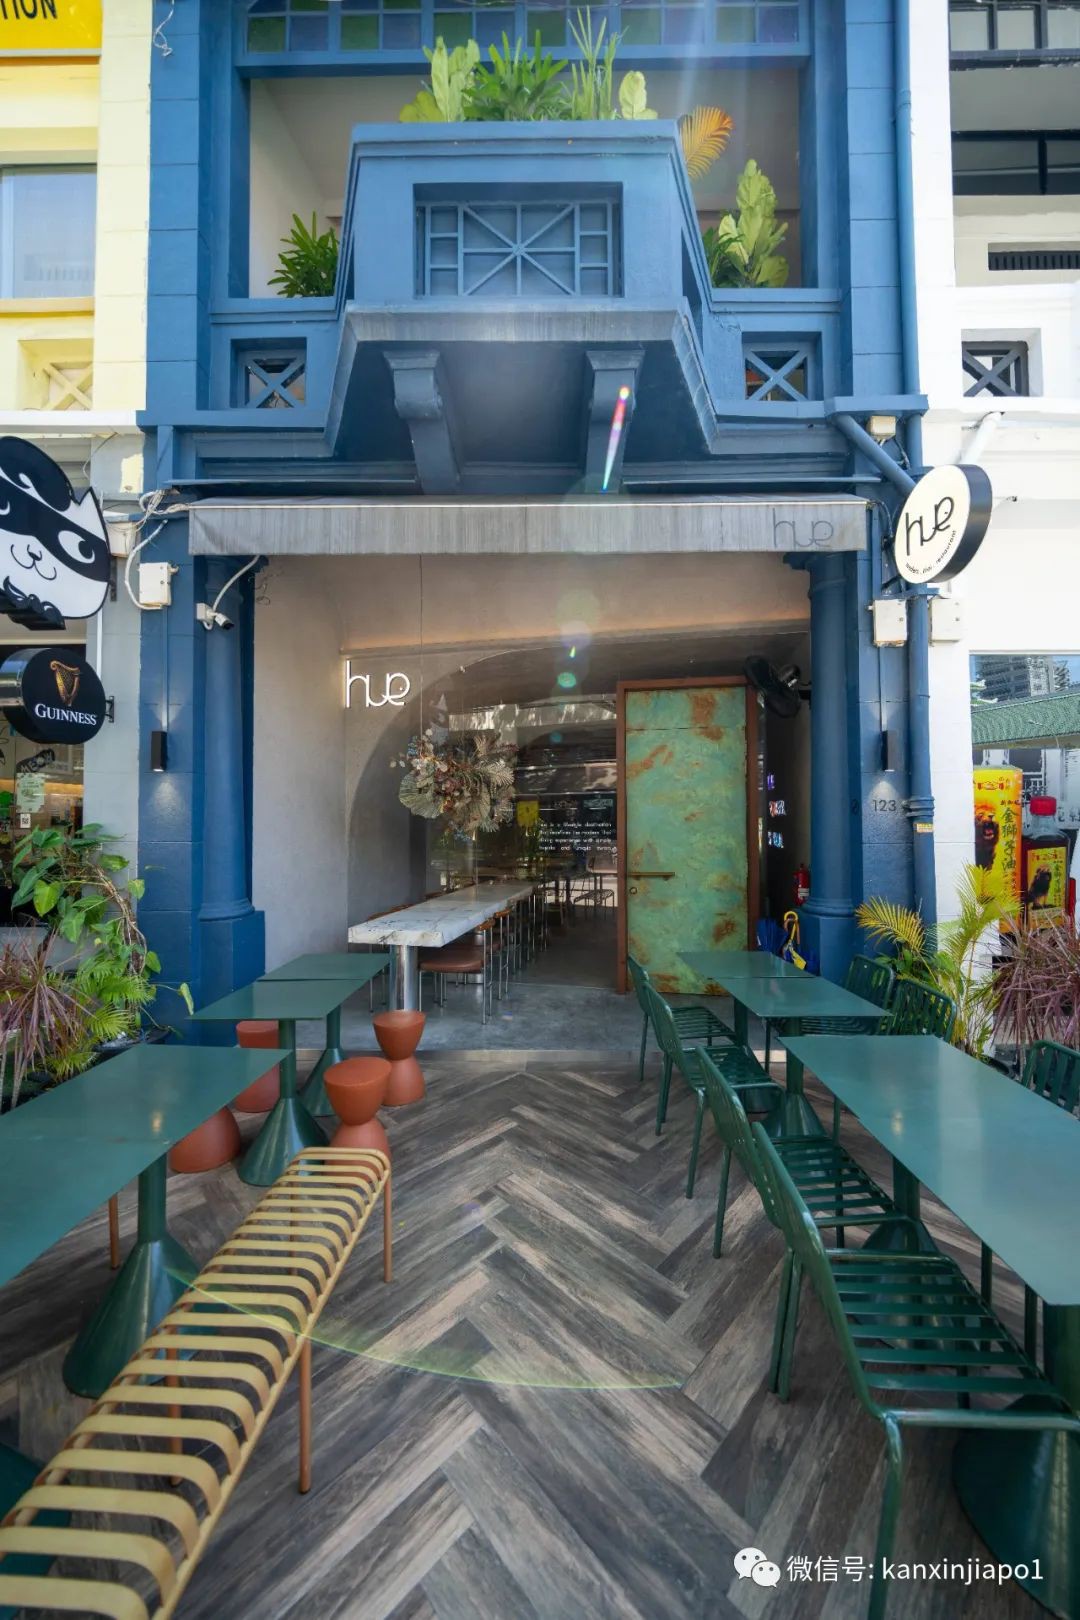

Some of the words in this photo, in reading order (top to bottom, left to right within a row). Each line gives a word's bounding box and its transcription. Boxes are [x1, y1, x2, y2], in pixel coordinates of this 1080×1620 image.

[905, 496, 955, 556] hue
[345, 660, 411, 708] hue
[34, 703, 97, 725] GUINNESS
[872, 799, 898, 812] 123
